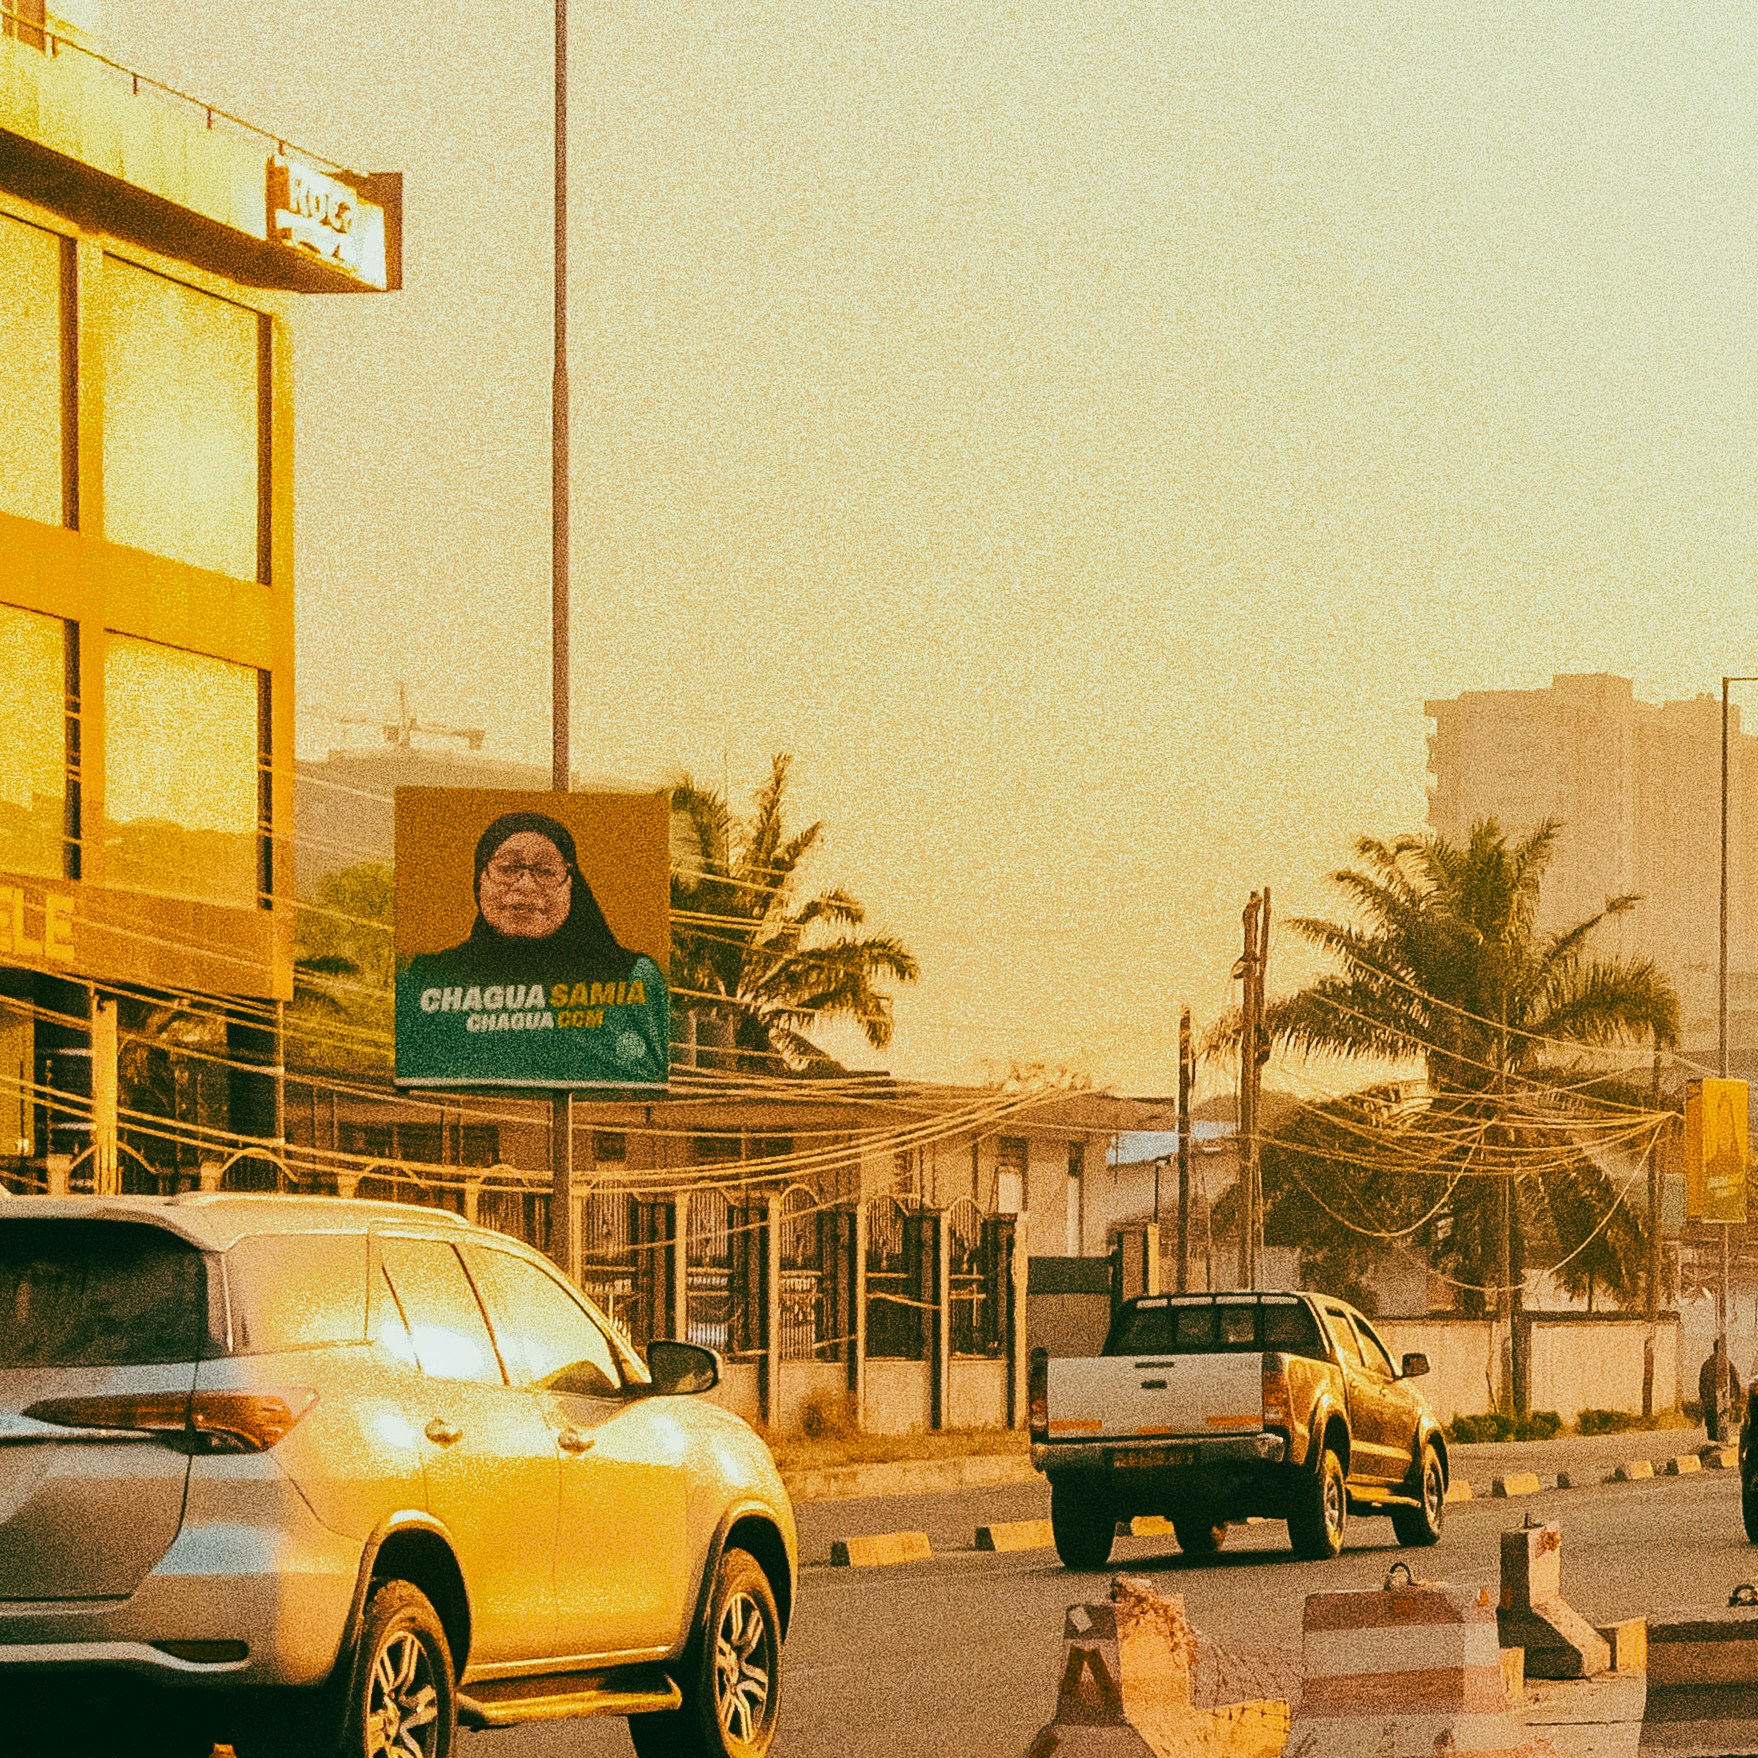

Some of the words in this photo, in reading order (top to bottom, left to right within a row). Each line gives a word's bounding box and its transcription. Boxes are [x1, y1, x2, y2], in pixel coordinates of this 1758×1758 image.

[421, 985, 546, 1012] CHAGUA
[550, 981, 647, 1006] SAMIA
[466, 1012, 554, 1033] CHAGUA
[556, 1009, 606, 1029] CCM
